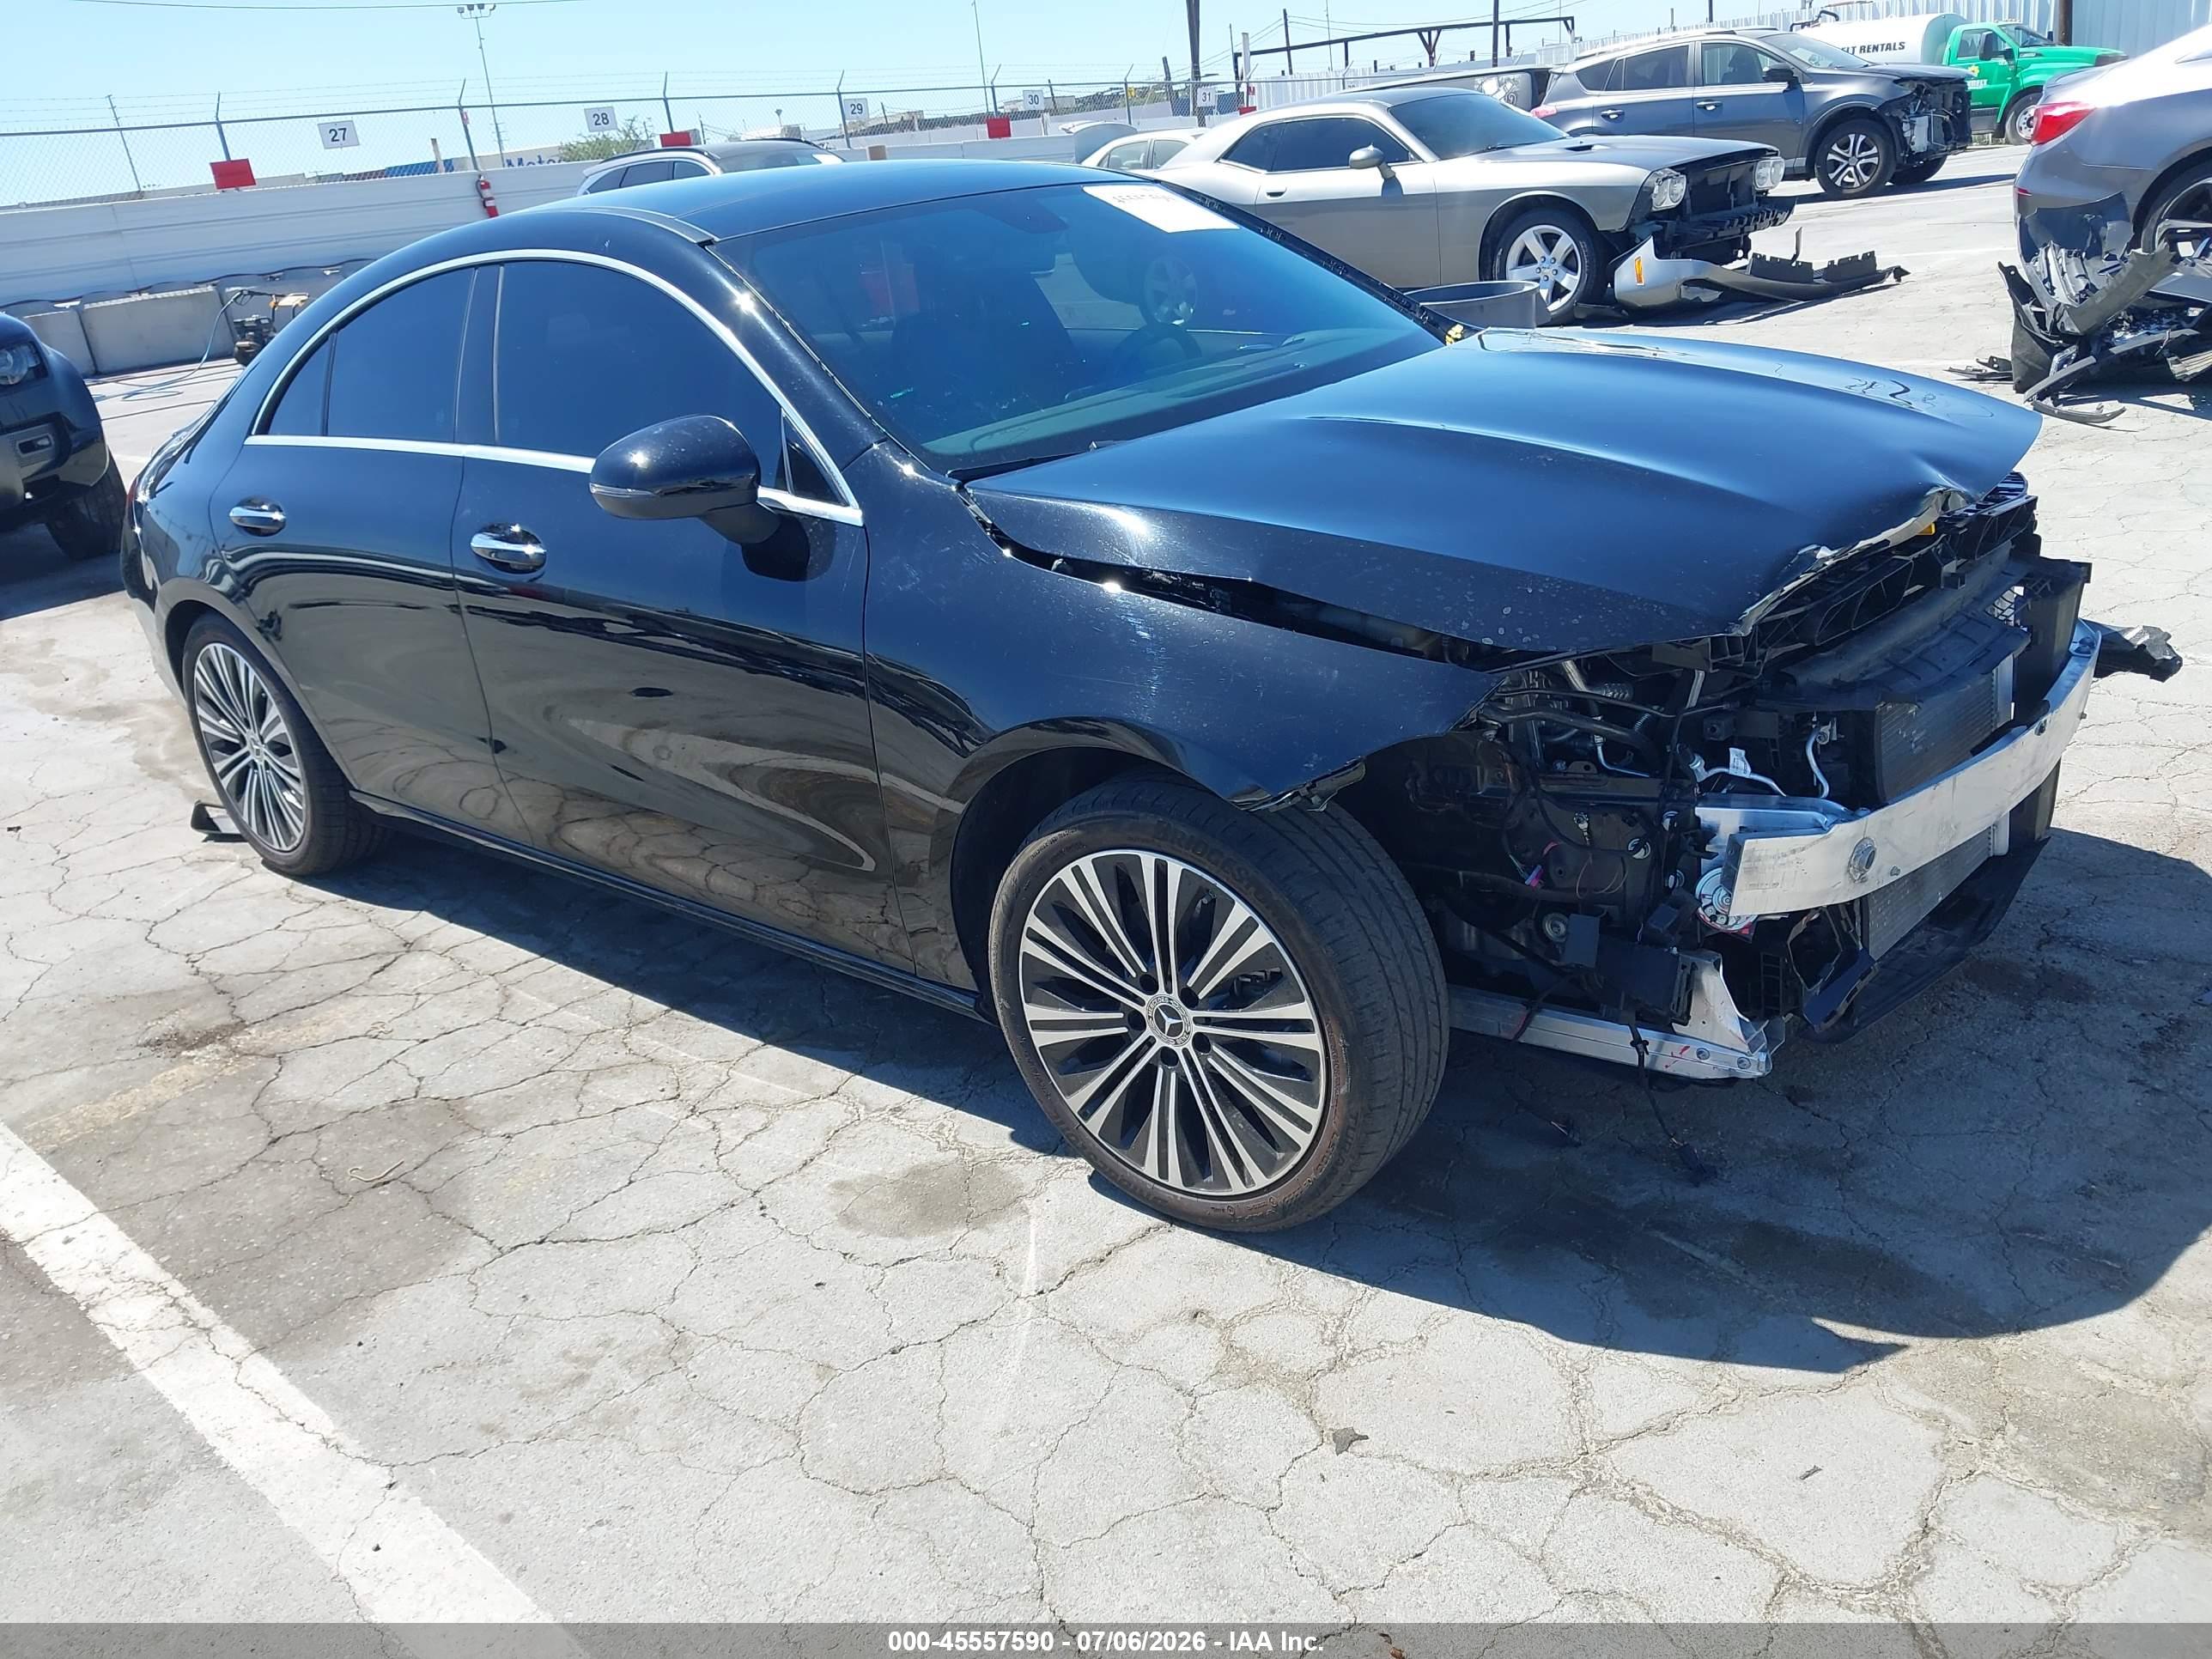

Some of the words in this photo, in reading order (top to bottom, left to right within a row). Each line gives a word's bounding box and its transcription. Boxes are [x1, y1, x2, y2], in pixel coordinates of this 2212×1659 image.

[1859, 41, 1905, 54] RENTALS
[1028, 94, 1039, 105] 30
[1202, 92, 1211, 102] 31
[850, 103, 863, 114] 29
[592, 112, 610, 125] 28
[329, 127, 347, 142] 27
